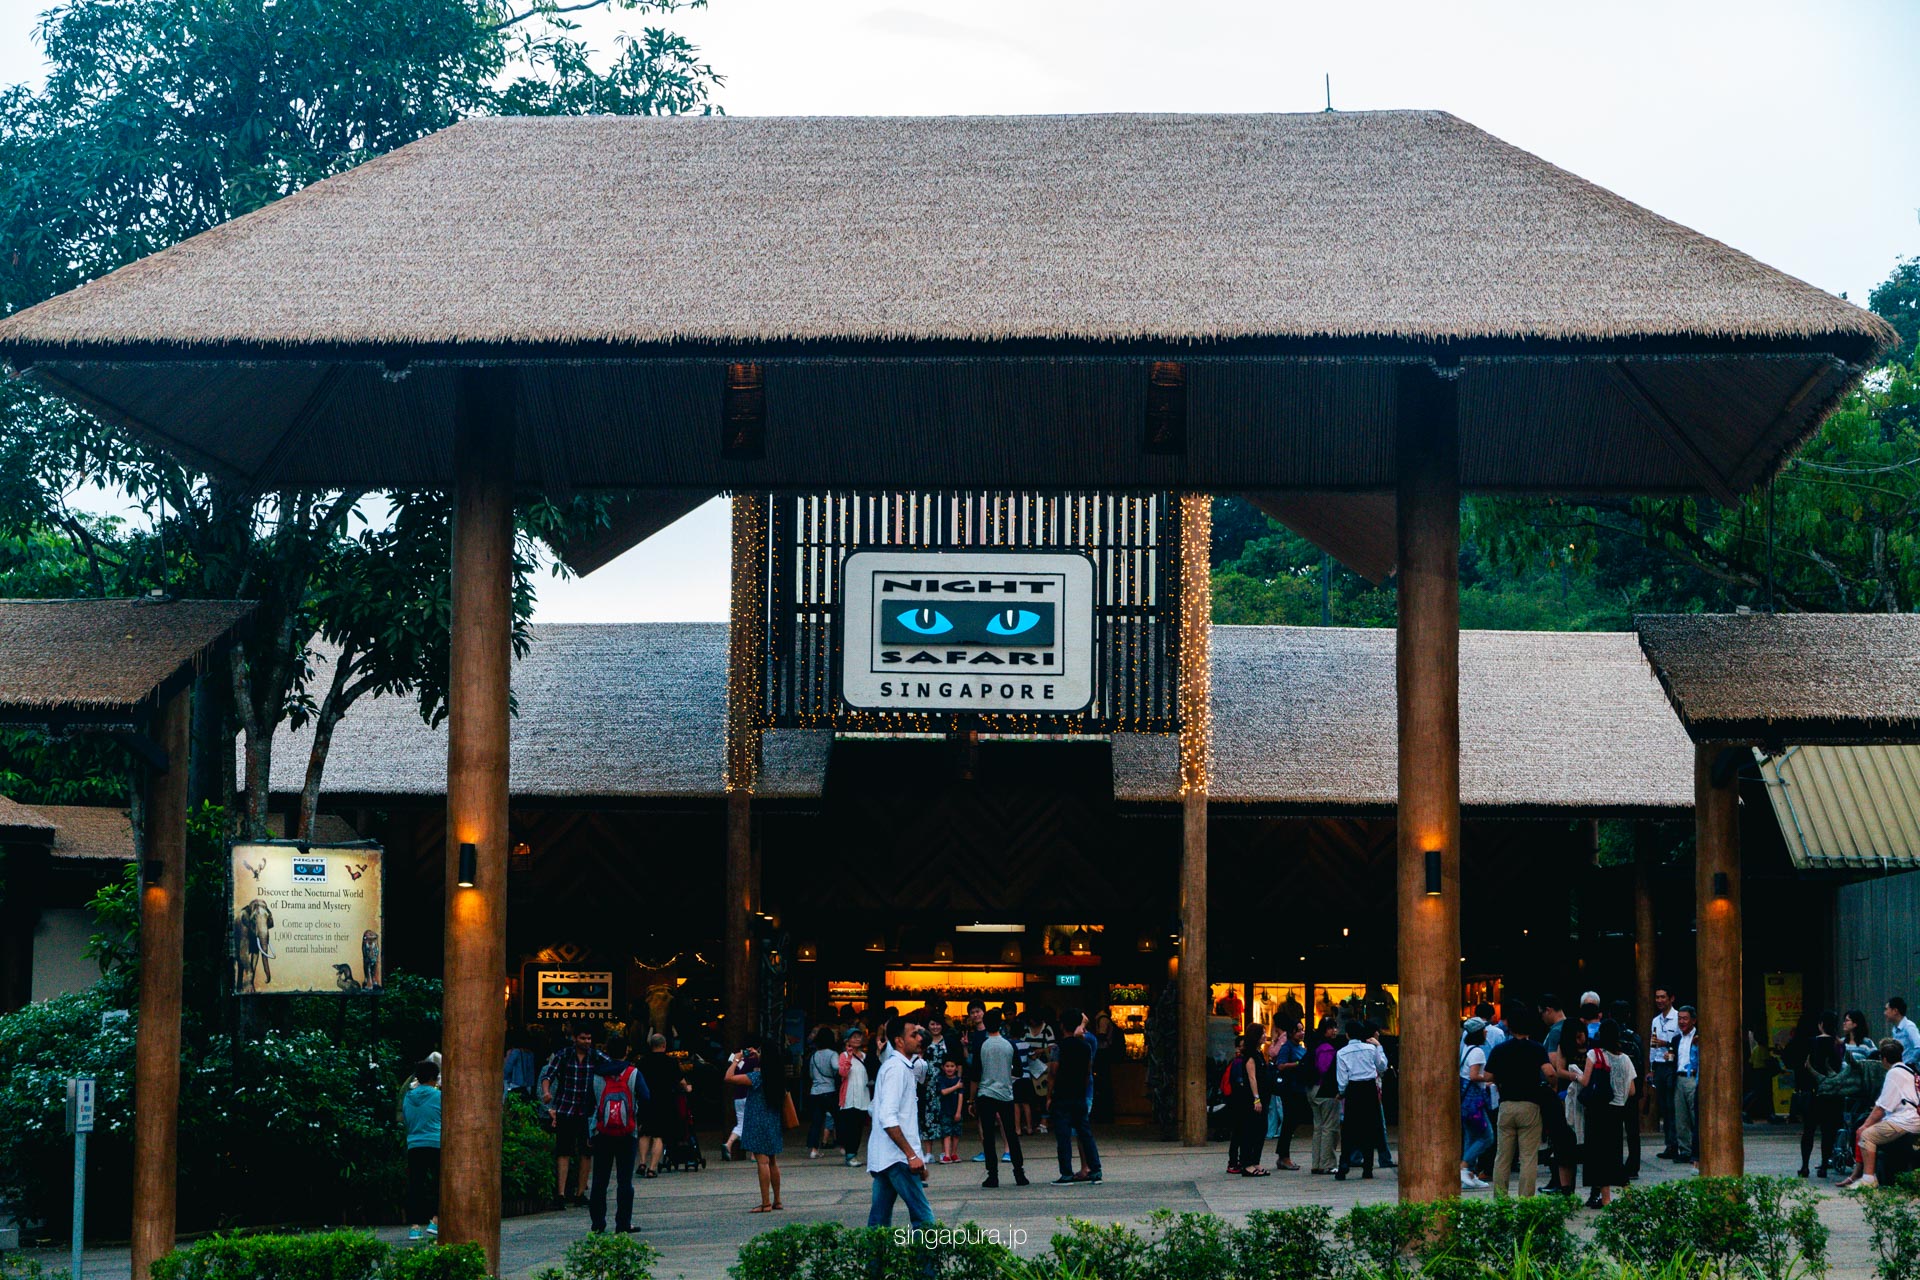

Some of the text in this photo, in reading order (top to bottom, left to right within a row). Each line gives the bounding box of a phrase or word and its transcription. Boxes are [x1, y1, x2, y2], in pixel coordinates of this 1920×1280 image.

[882, 579, 1056, 594] NIGHT
[880, 650, 1055, 666] SAFARI
[880, 682, 1055, 700] SINGAPORE
[257, 887, 364, 898] Discover the Nocturnal World
[270, 900, 352, 913] of Drama and Mystery
[282, 919, 341, 931] Come up close to
[274, 931, 349, 942] 1,000 creatures in their
[285, 944, 339, 954] natural habitats!
[1060, 976, 1076, 984] EXIT
